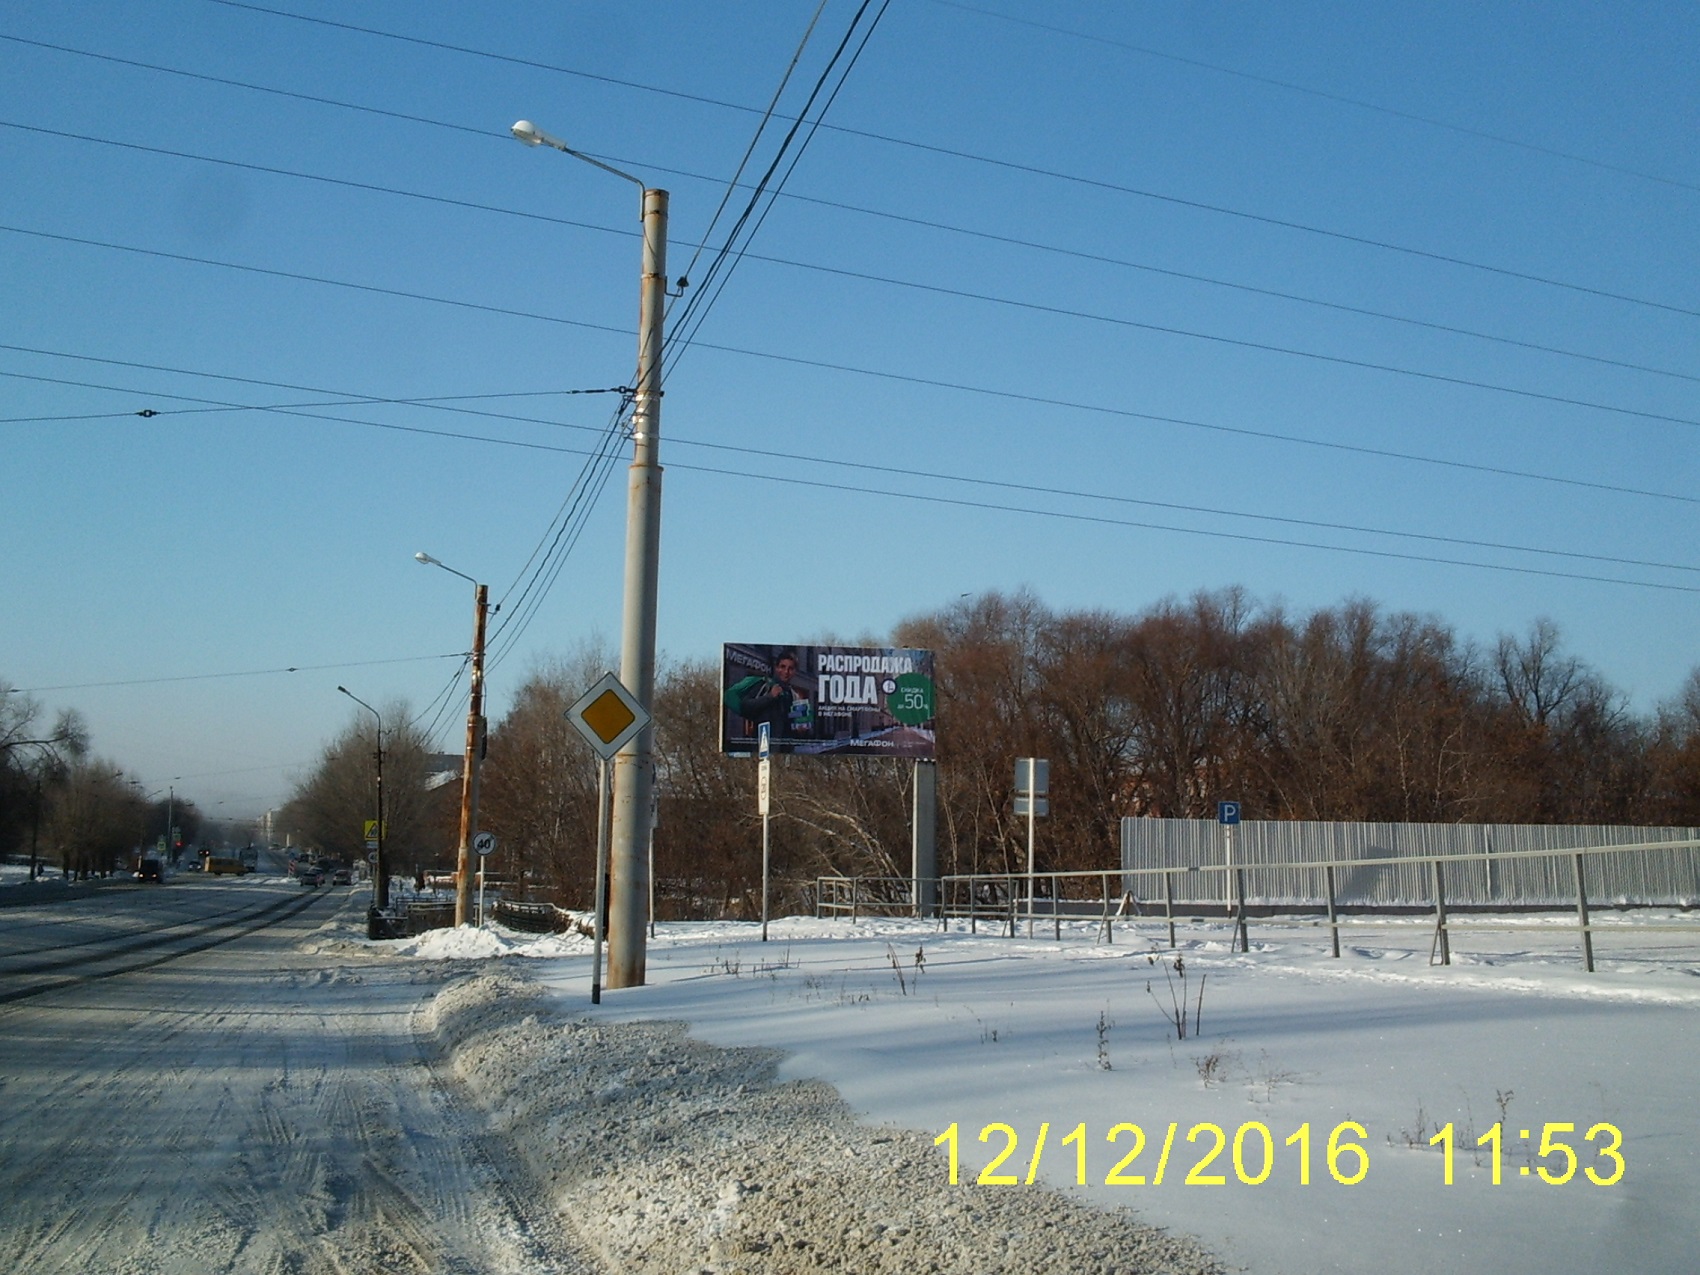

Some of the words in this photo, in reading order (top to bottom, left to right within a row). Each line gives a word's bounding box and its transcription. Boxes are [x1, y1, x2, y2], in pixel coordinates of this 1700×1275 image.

[818, 653, 913, 675] РАСПРОДАЖА
[818, 674, 878, 705] ГОДА
[1224, 804, 1236, 822] P
[477, 839, 491, 849] 40
